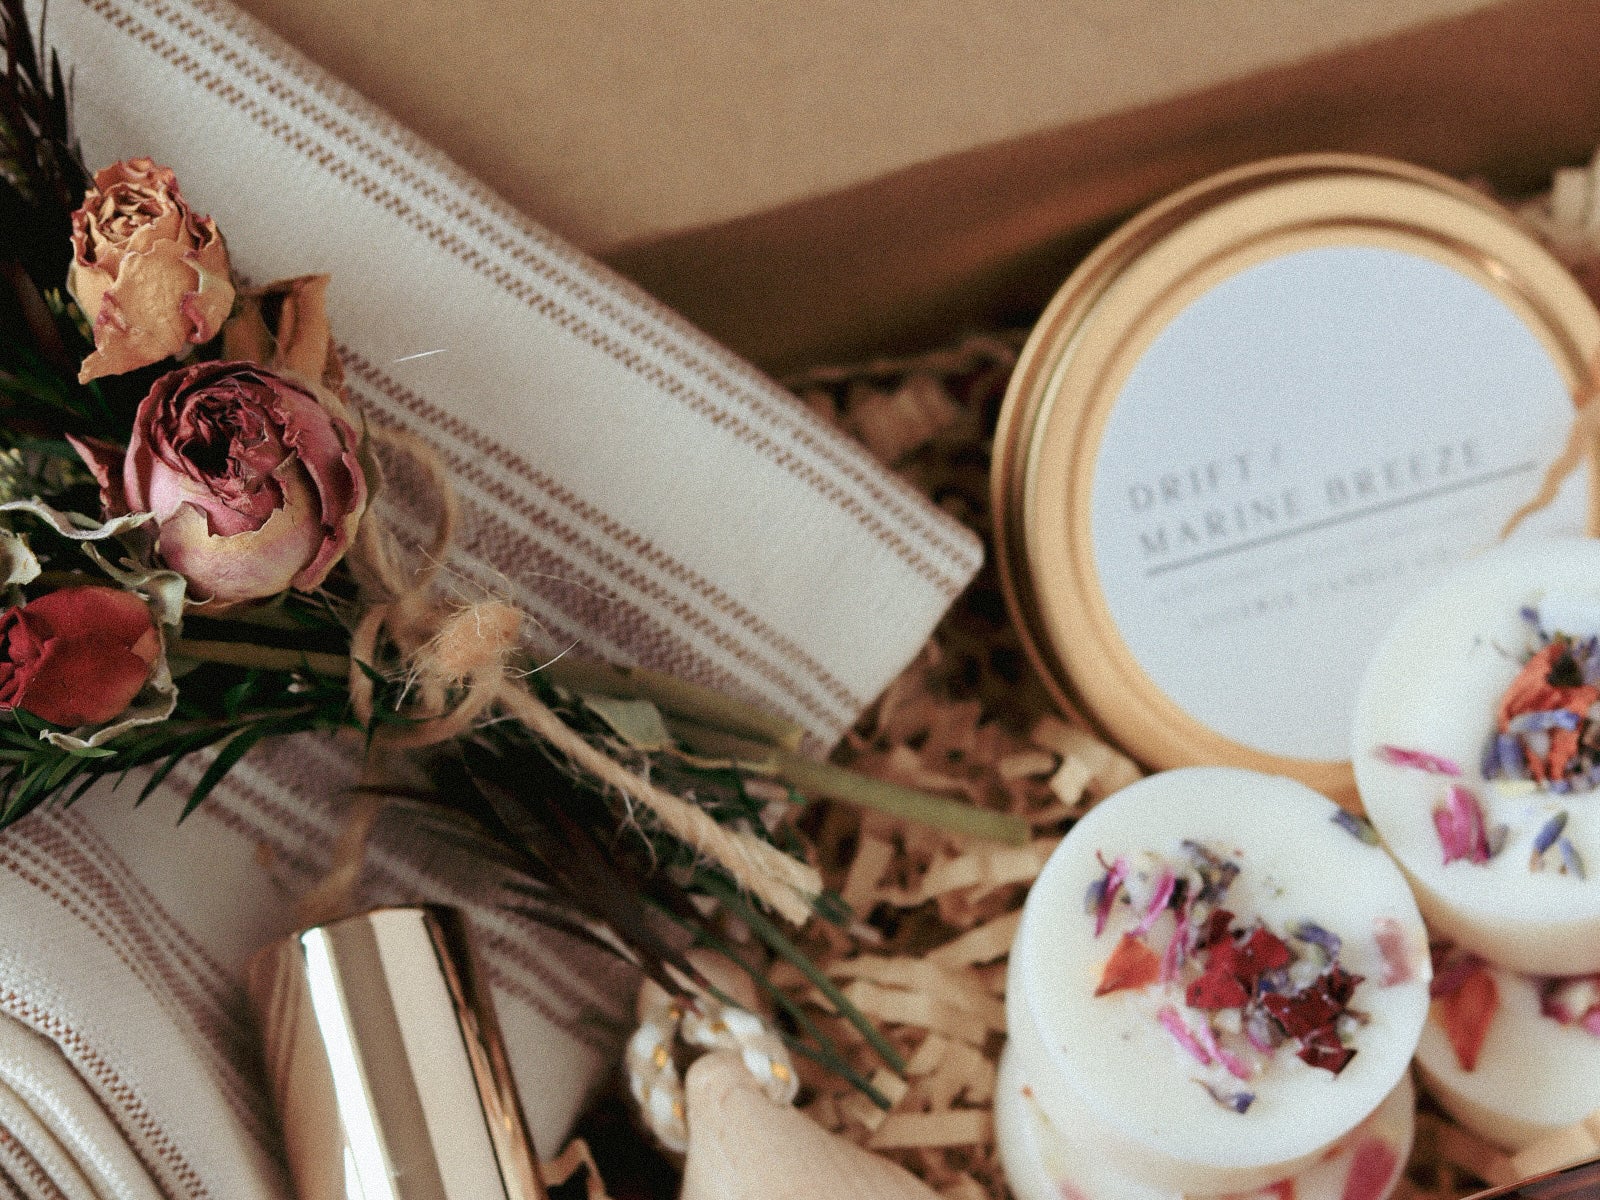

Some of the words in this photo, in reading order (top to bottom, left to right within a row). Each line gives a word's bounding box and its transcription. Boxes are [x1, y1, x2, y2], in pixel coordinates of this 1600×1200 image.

[1128, 450, 1254, 512] DRIFT
[1137, 486, 1303, 557] MARINE
[1324, 438, 1484, 506] BREEZE
